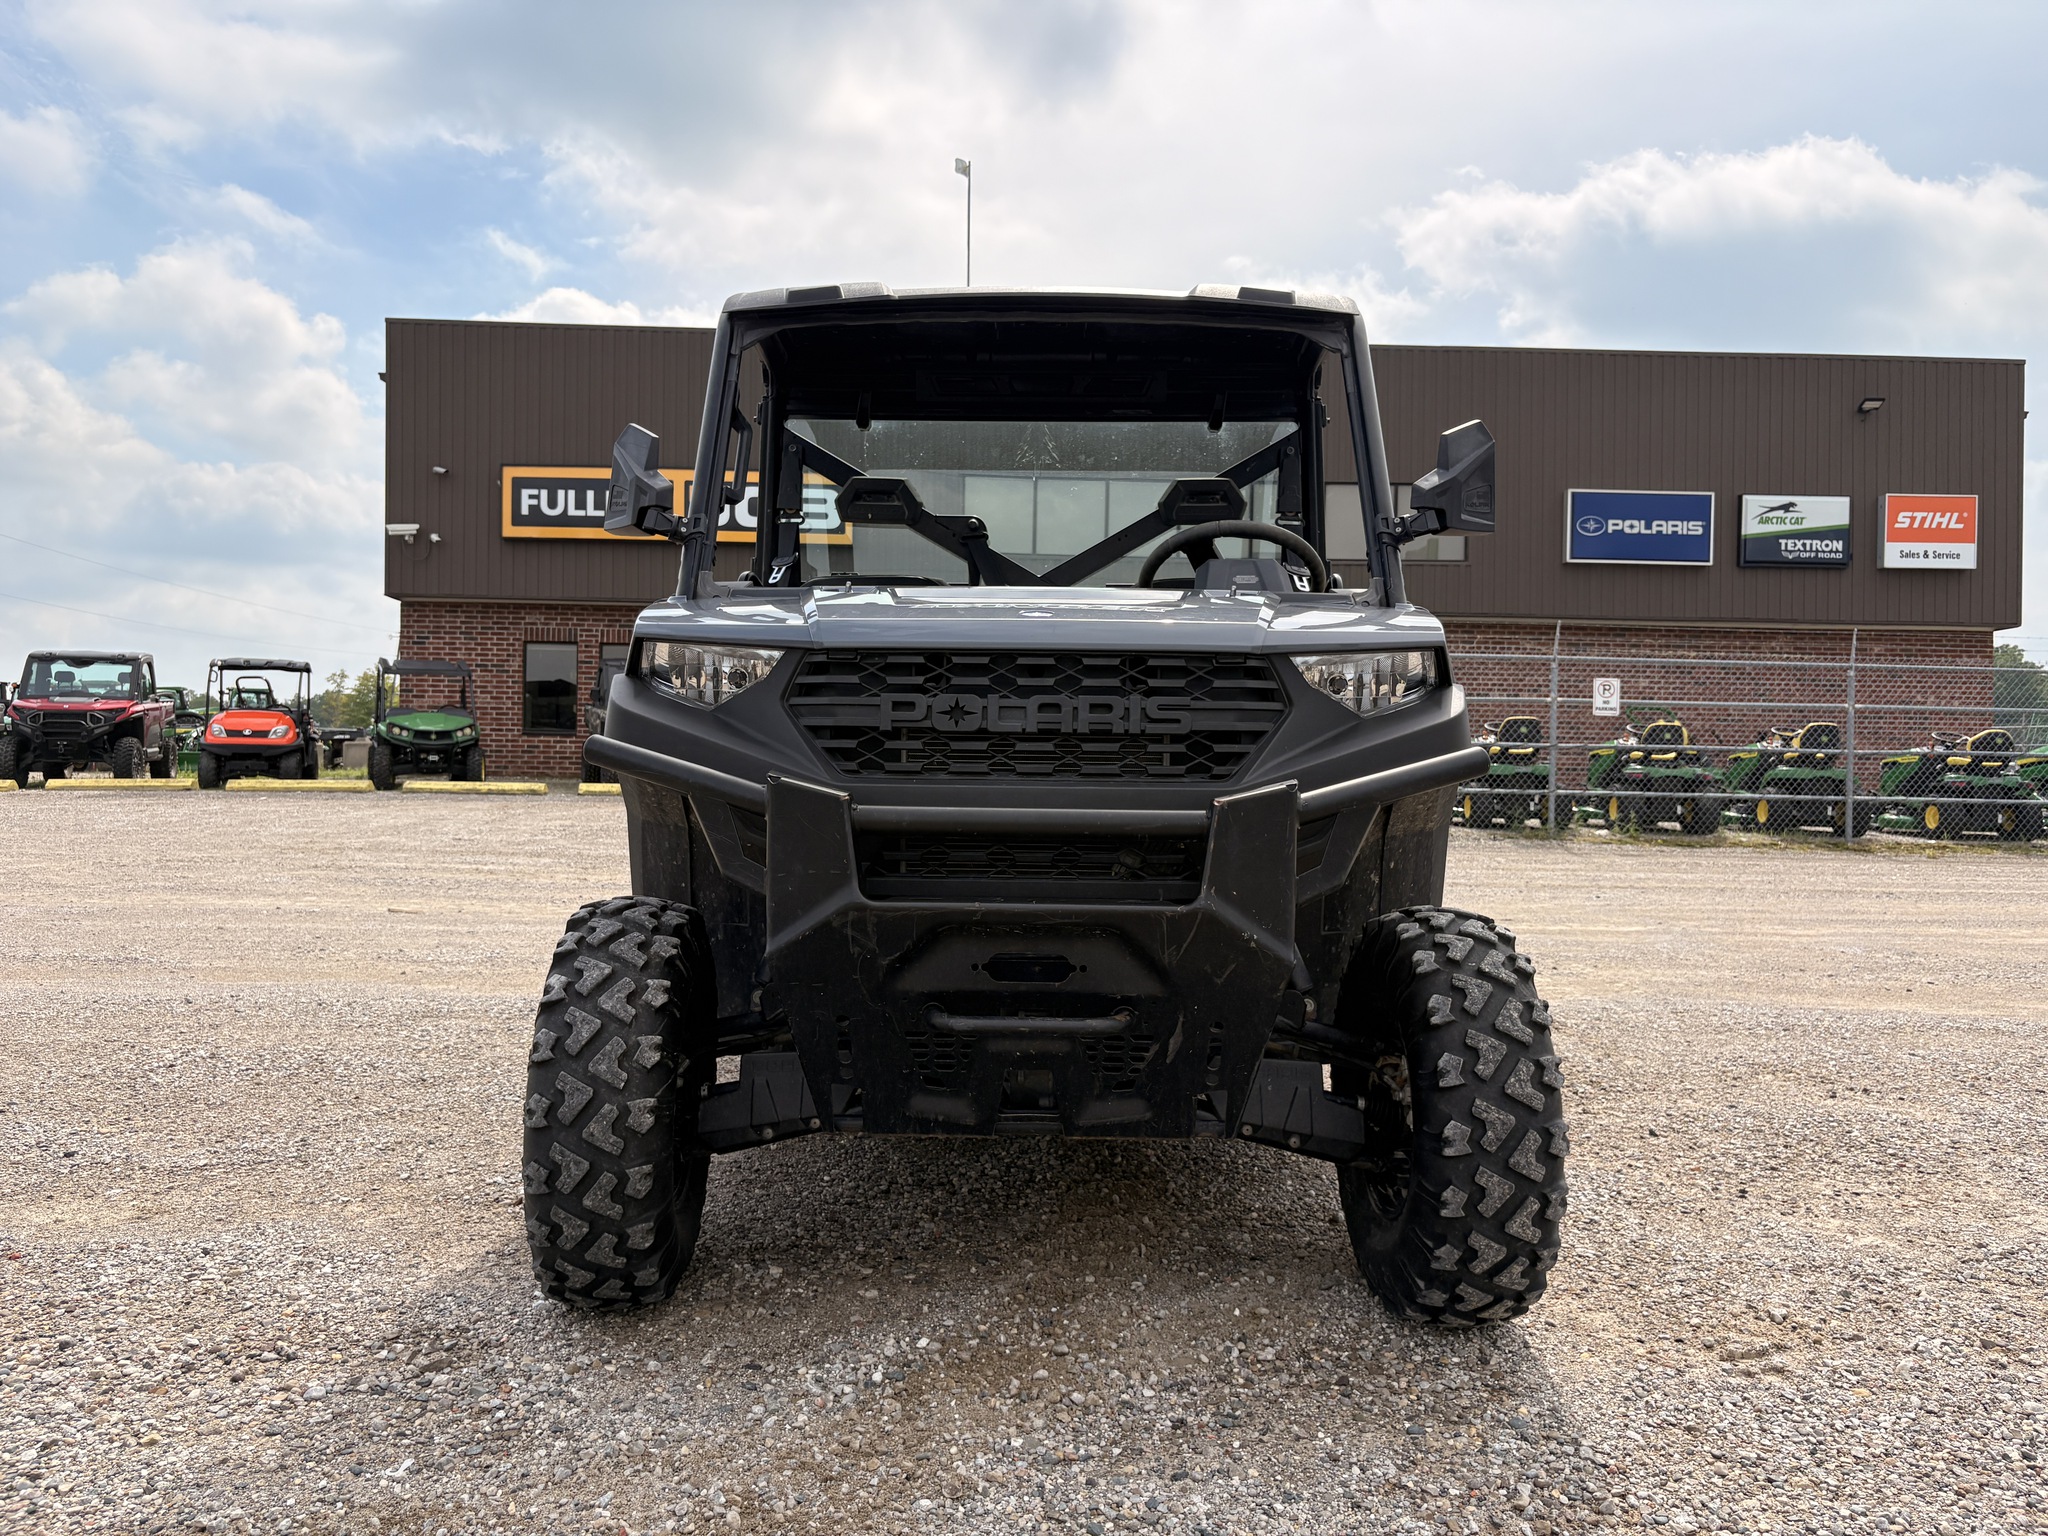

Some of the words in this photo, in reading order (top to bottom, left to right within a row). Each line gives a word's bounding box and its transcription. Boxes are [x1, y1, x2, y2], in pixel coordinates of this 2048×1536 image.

[1607, 518, 1704, 536] POLARIS
[1757, 516, 1788, 525] ARCTIC
[1789, 516, 1806, 526] CAT
[1893, 511, 1965, 529] STIHL
[1779, 539, 1843, 551] TEXTRON
[1899, 550, 1920, 559] Sales
[1922, 550, 1930, 559] &
[1932, 550, 1961, 560] Service
[879, 693, 1193, 734] POLARIS
